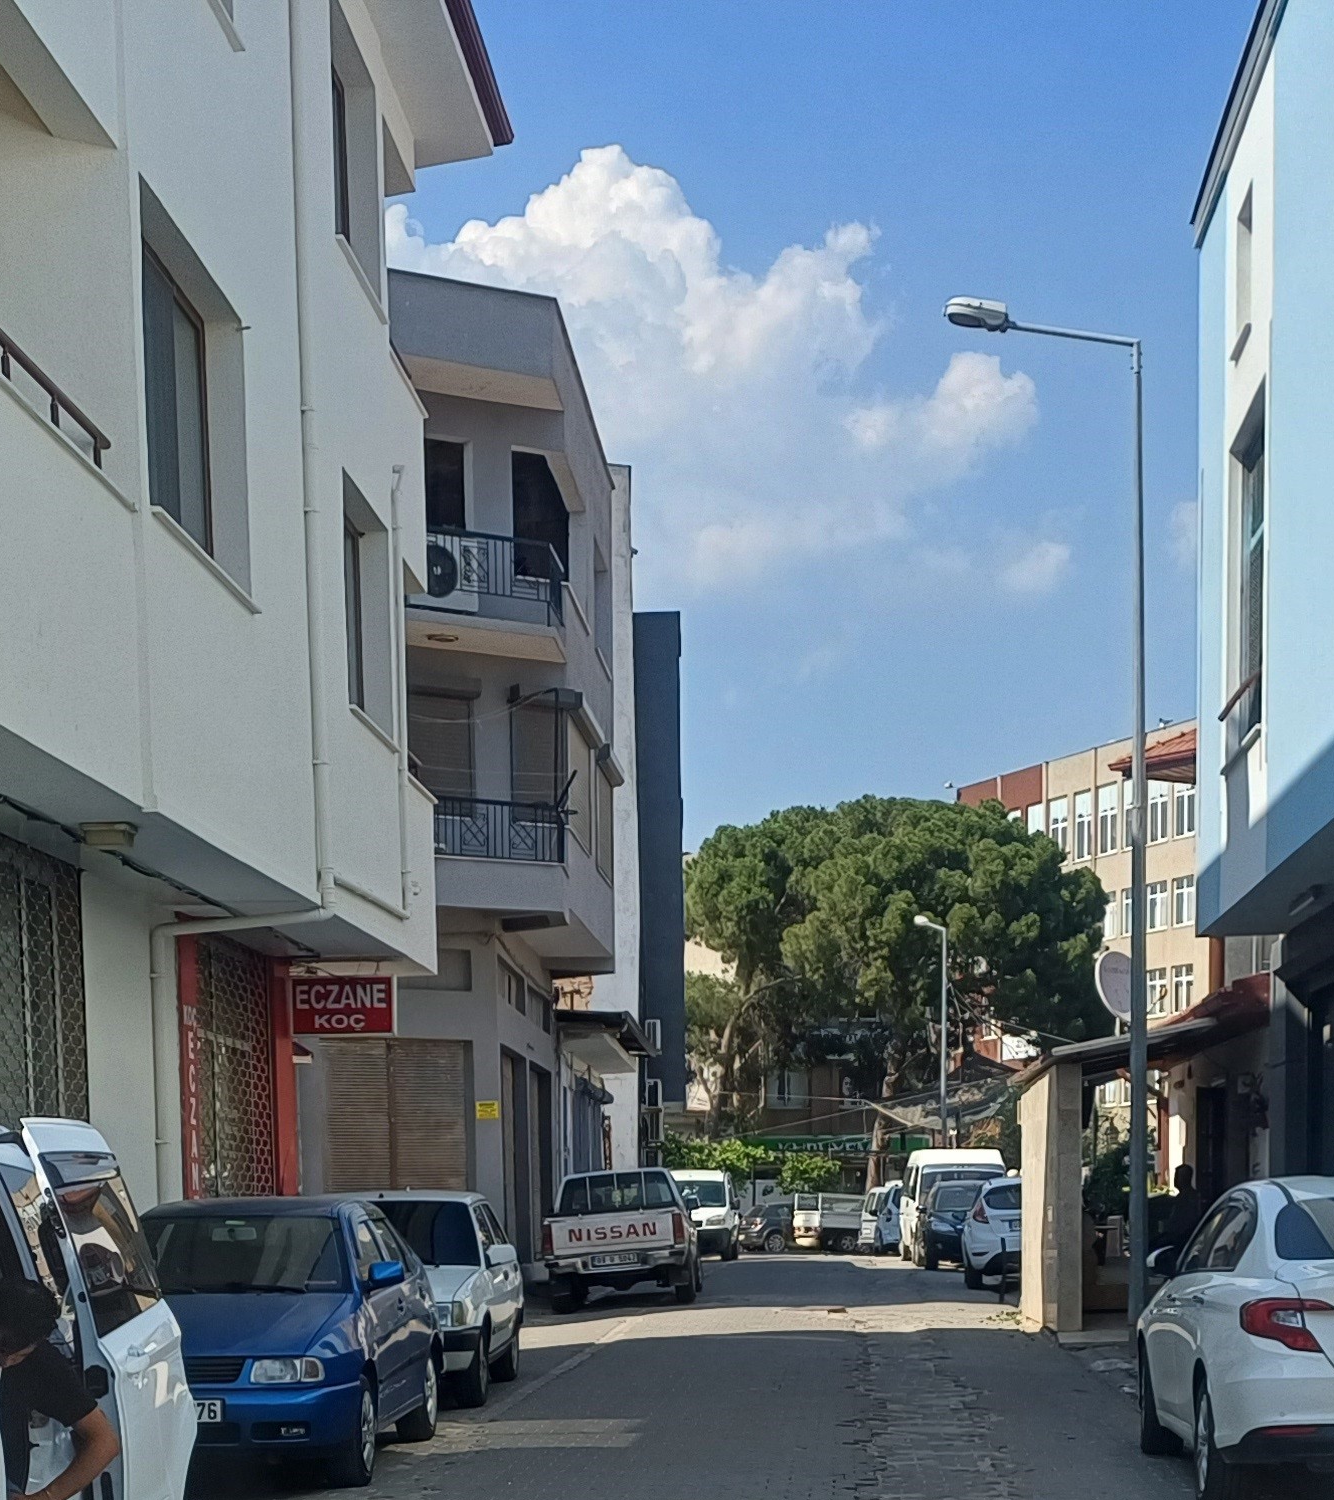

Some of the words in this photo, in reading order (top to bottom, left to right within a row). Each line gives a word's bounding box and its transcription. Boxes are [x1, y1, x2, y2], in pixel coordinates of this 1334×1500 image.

[296, 984, 387, 1009] ECZANE
[314, 1014, 365, 1031] KOÇ
[188, 1031, 199, 1199] ECZAN
[568, 1222, 657, 1242] NISSAN
